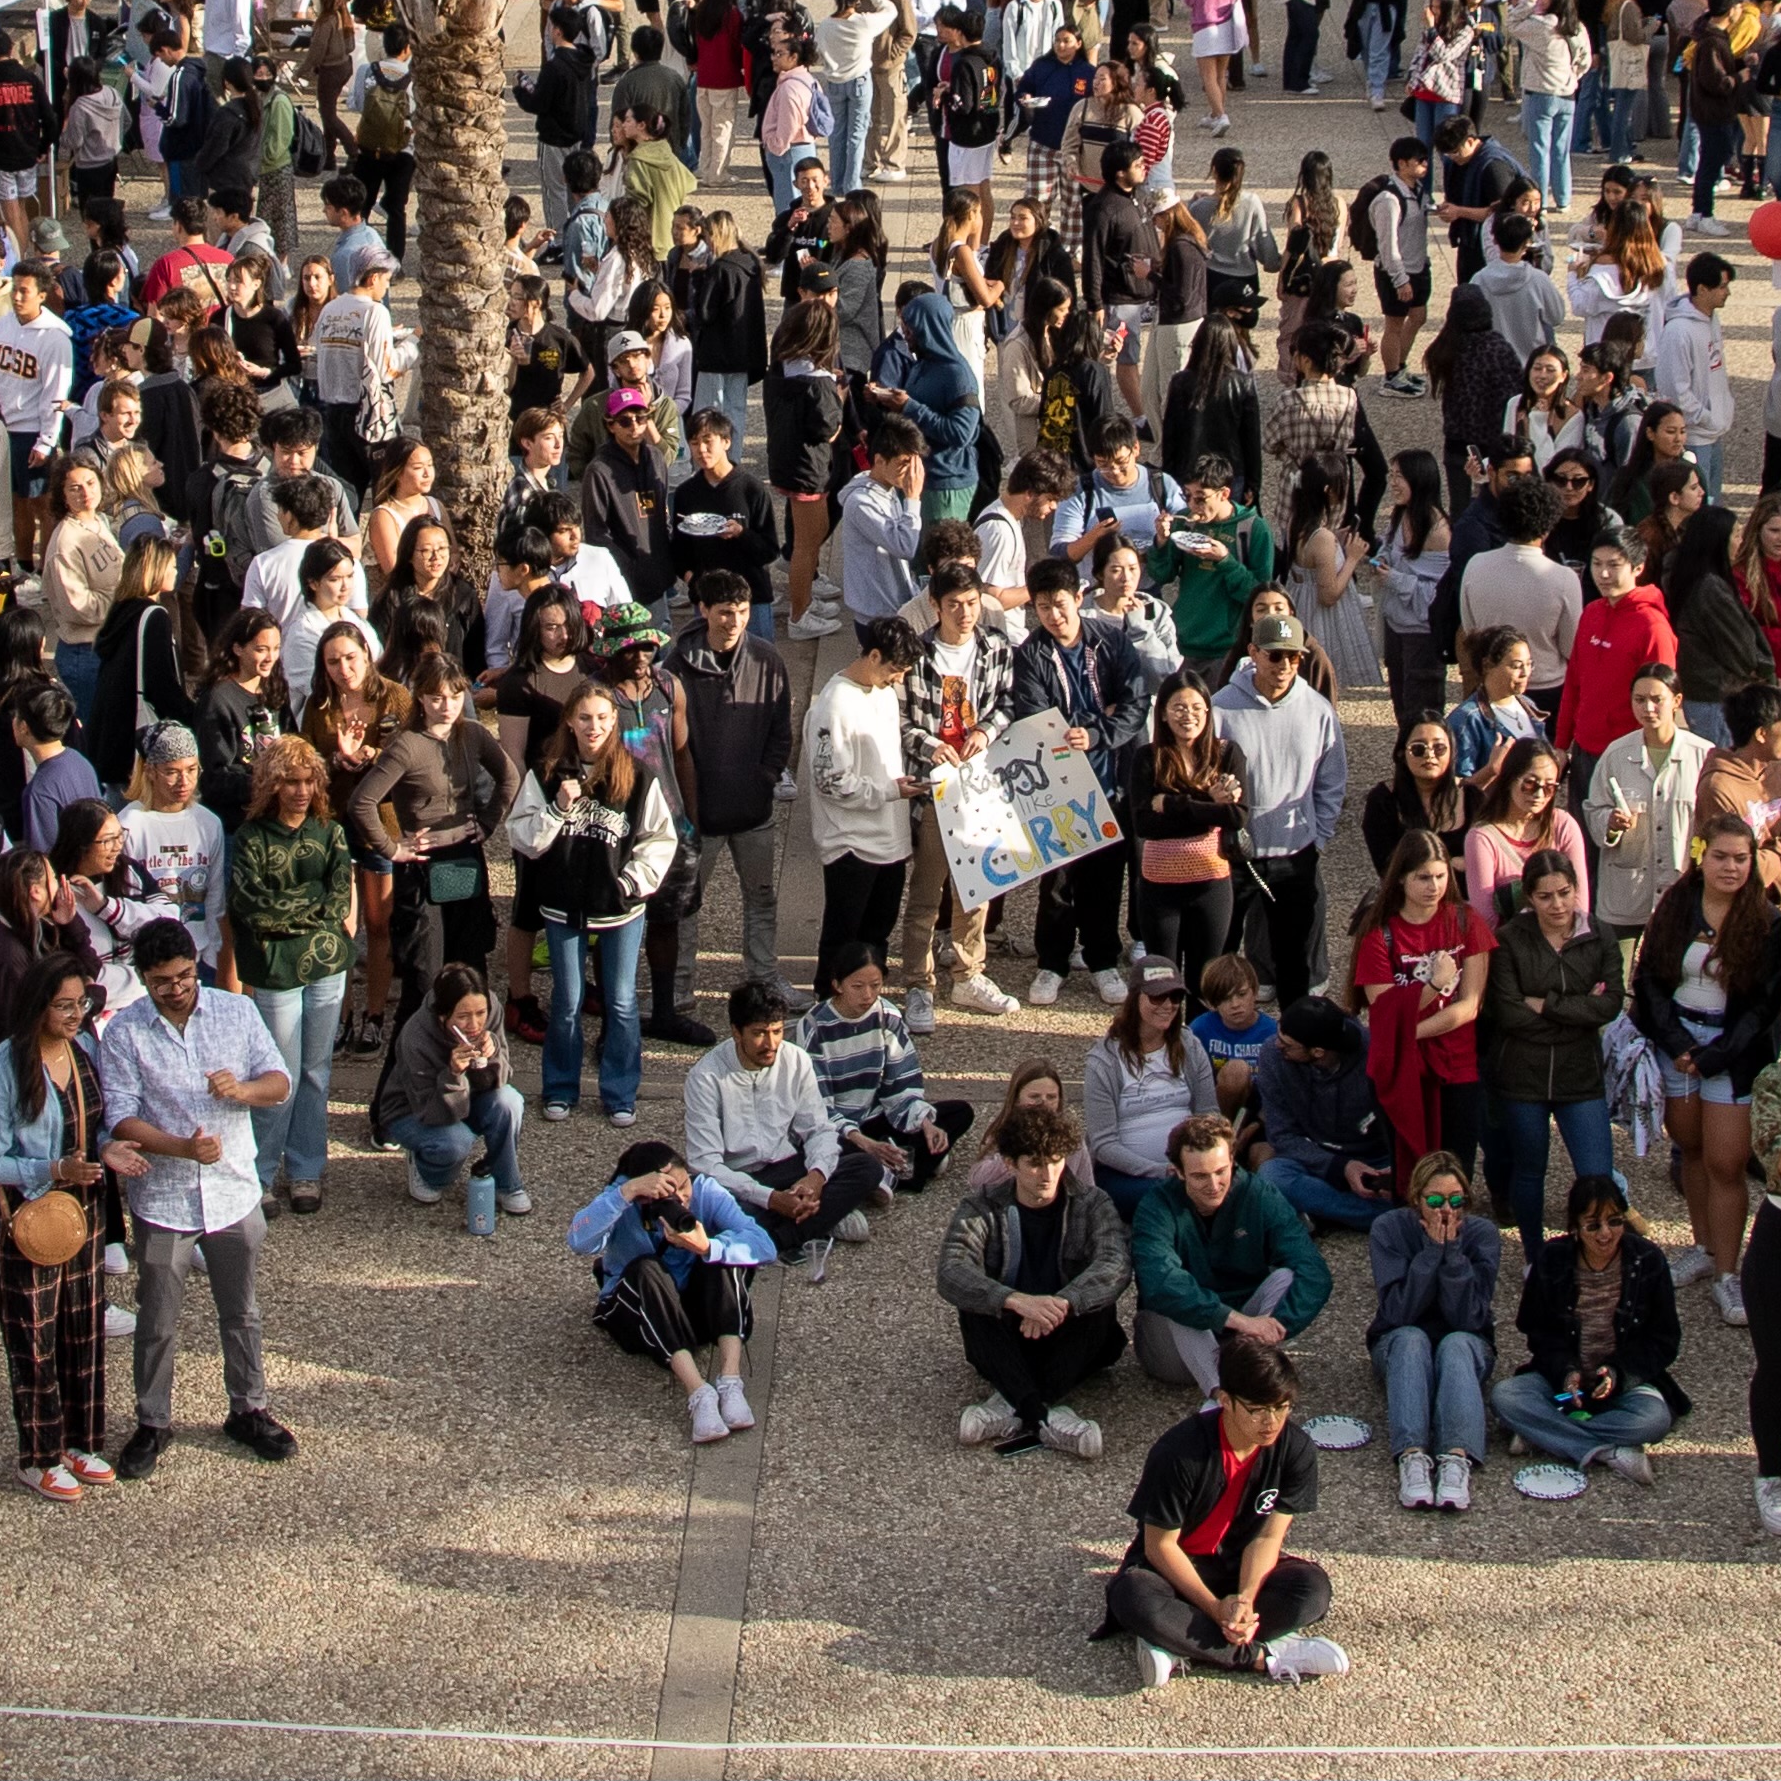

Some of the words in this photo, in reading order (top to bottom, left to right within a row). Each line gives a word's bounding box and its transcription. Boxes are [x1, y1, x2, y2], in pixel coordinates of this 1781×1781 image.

[1280, 621, 1292, 638] LA
[1018, 793, 1057, 816] like
[561, 824, 618, 848] THLETIC
[981, 789, 1102, 886] CURRY
[197, 852, 210, 866] Ba
[1234, 1043, 1262, 1057] CHAR
